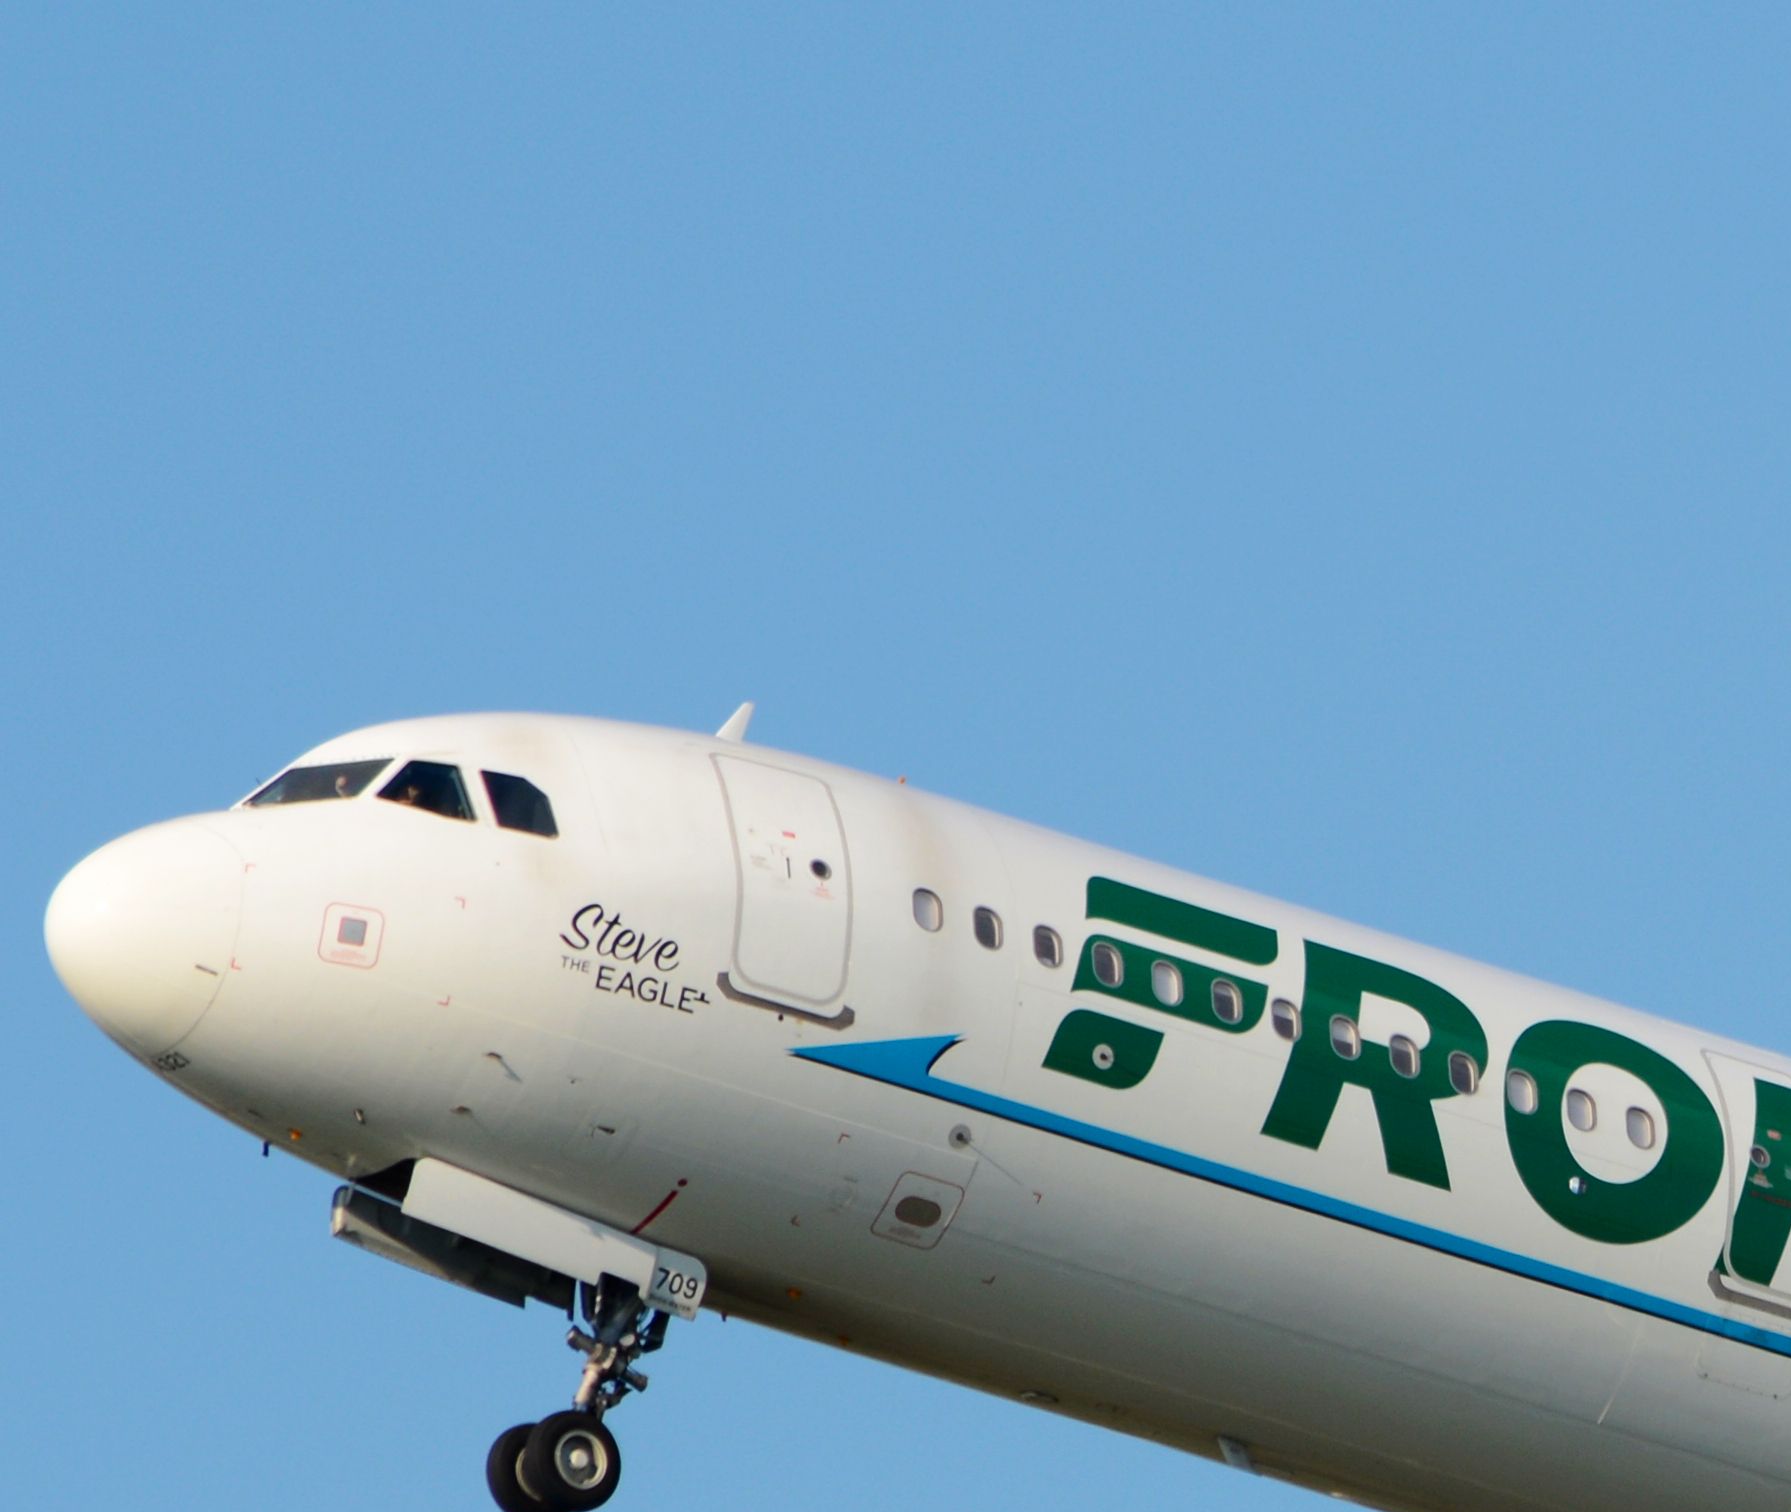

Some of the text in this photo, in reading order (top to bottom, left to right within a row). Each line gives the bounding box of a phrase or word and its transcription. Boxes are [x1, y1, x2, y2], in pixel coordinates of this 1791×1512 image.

[559, 903, 679, 971] Steve
[595, 965, 698, 1013] EAGLE
[656, 1267, 698, 1299] 709
